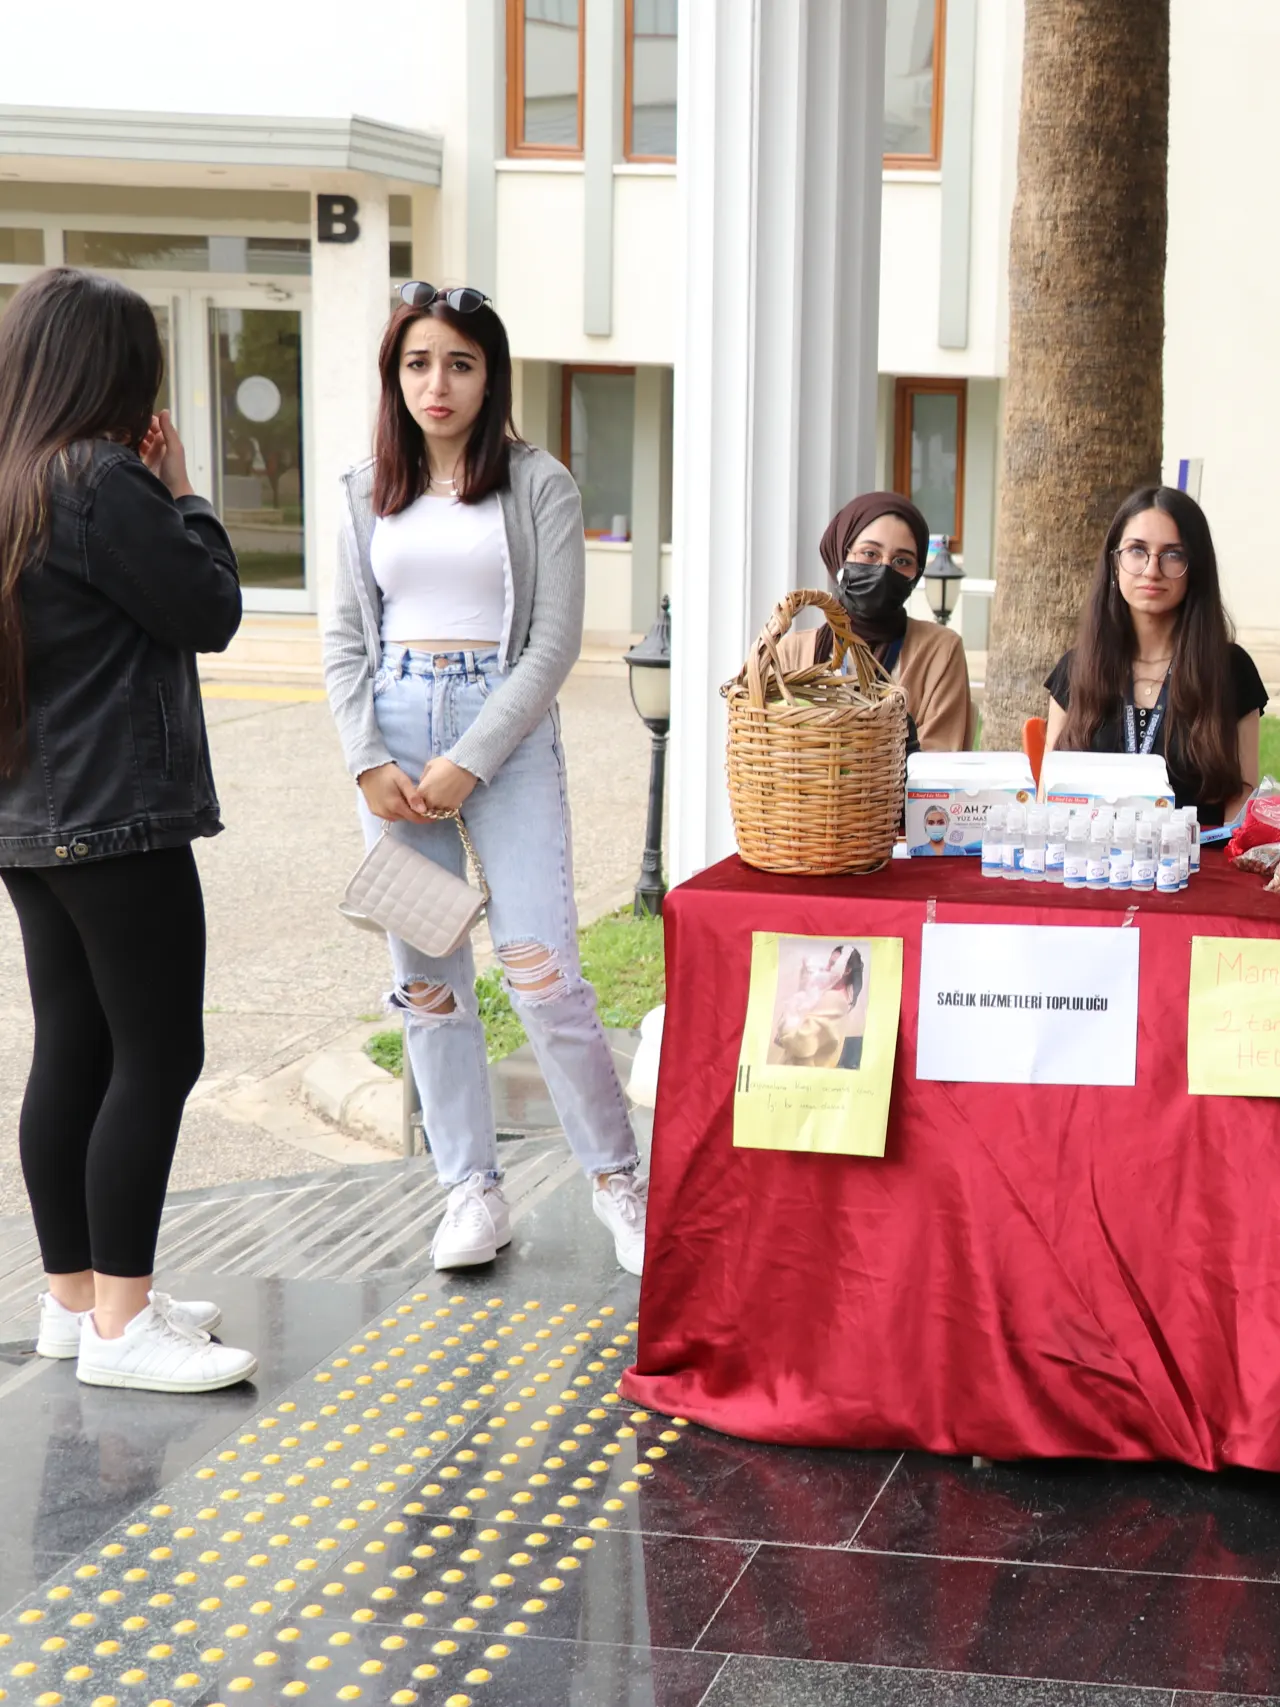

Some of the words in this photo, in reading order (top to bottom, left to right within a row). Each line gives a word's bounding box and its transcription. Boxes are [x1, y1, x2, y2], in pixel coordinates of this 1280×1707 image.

[317, 194, 360, 243] B
[1146, 713, 1160, 736] TOROS
[937, 990, 976, 1007] SAĞLIK
[979, 990, 1042, 1009] HİZMETLERİ
[1046, 994, 1108, 1011] TOPLULUĞU
[1213, 1010, 1241, 1033] 2
